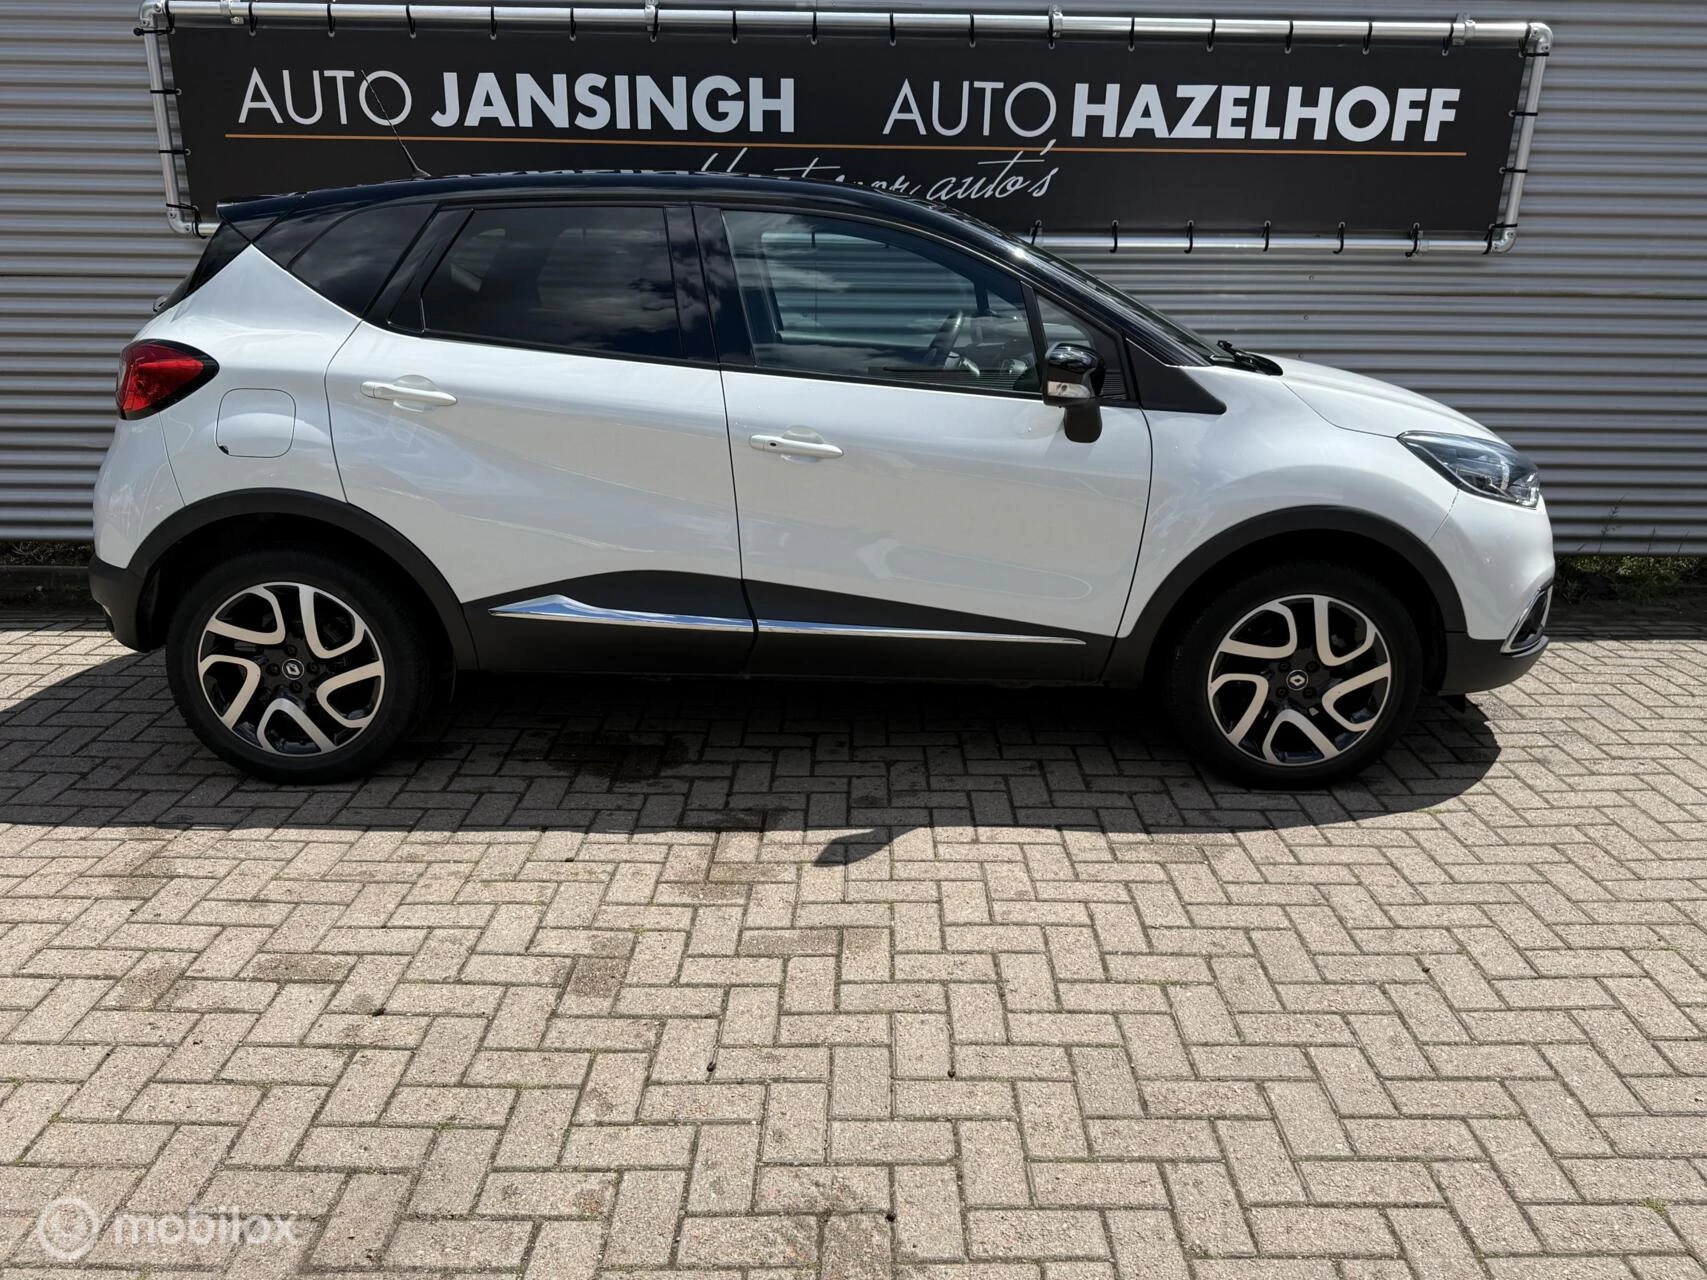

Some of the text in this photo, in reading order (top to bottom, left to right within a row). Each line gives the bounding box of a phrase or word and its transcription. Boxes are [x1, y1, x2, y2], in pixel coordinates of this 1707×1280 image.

[238, 66, 795, 134] AUTO JANSINGH
[882, 77, 1460, 142] AUTO HAZELHOFF
[926, 139, 1059, 200] auto's
